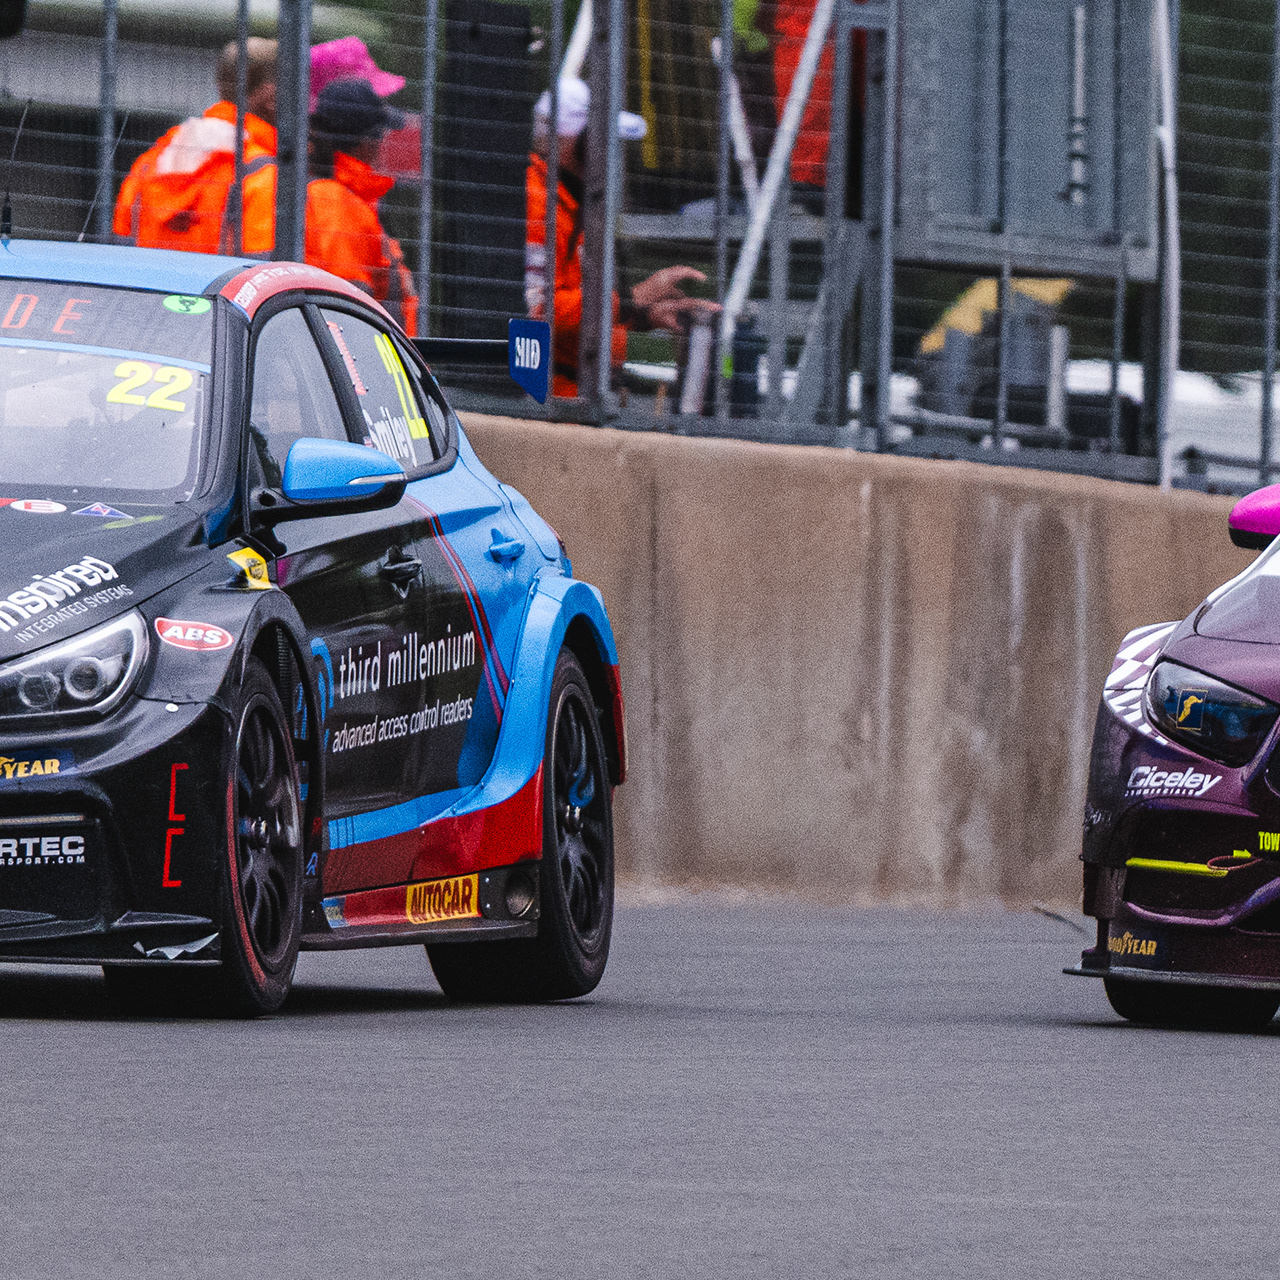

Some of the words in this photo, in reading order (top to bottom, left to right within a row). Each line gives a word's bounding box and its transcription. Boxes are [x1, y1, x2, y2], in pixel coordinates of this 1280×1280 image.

[106, 361, 193, 412] 22
[14, 600, 87, 643] INTEGRATED
[86, 583, 134, 609] SYSTEMS
[161, 625, 222, 645] ABS
[339, 640, 381, 699] third
[387, 623, 475, 687] millennium
[332, 714, 378, 753] advanced
[378, 714, 409, 742] access
[410, 698, 439, 734] control
[440, 693, 473, 726] readers
[1127, 765, 1223, 797] Ciceley
[1258, 831, 1280, 852] TOW
[410, 877, 474, 921] AUTOCAR
